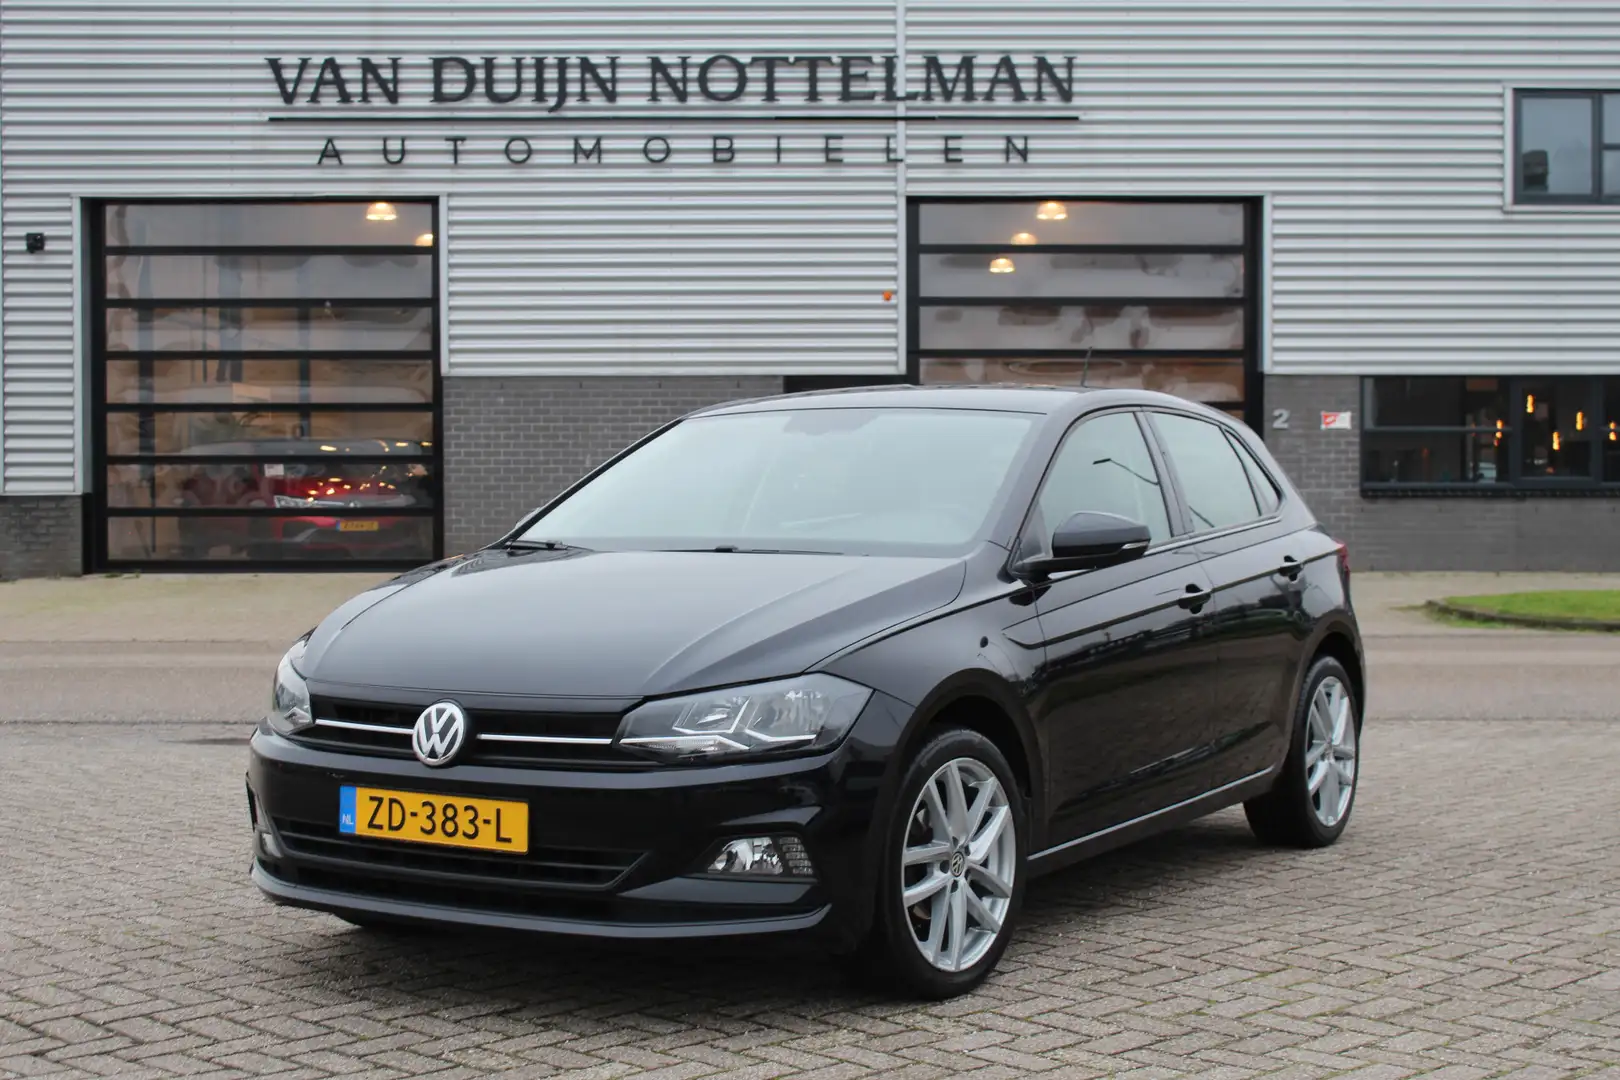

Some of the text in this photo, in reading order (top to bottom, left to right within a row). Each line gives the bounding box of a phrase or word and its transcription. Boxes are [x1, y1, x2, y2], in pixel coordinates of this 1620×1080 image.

[264, 54, 1078, 113] VAN DUIJN NOTTELMAN
[317, 135, 1030, 165] AUTOMOBIELEN
[1272, 408, 1290, 429] 2
[341, 795, 513, 844] NL ZD-383-L
